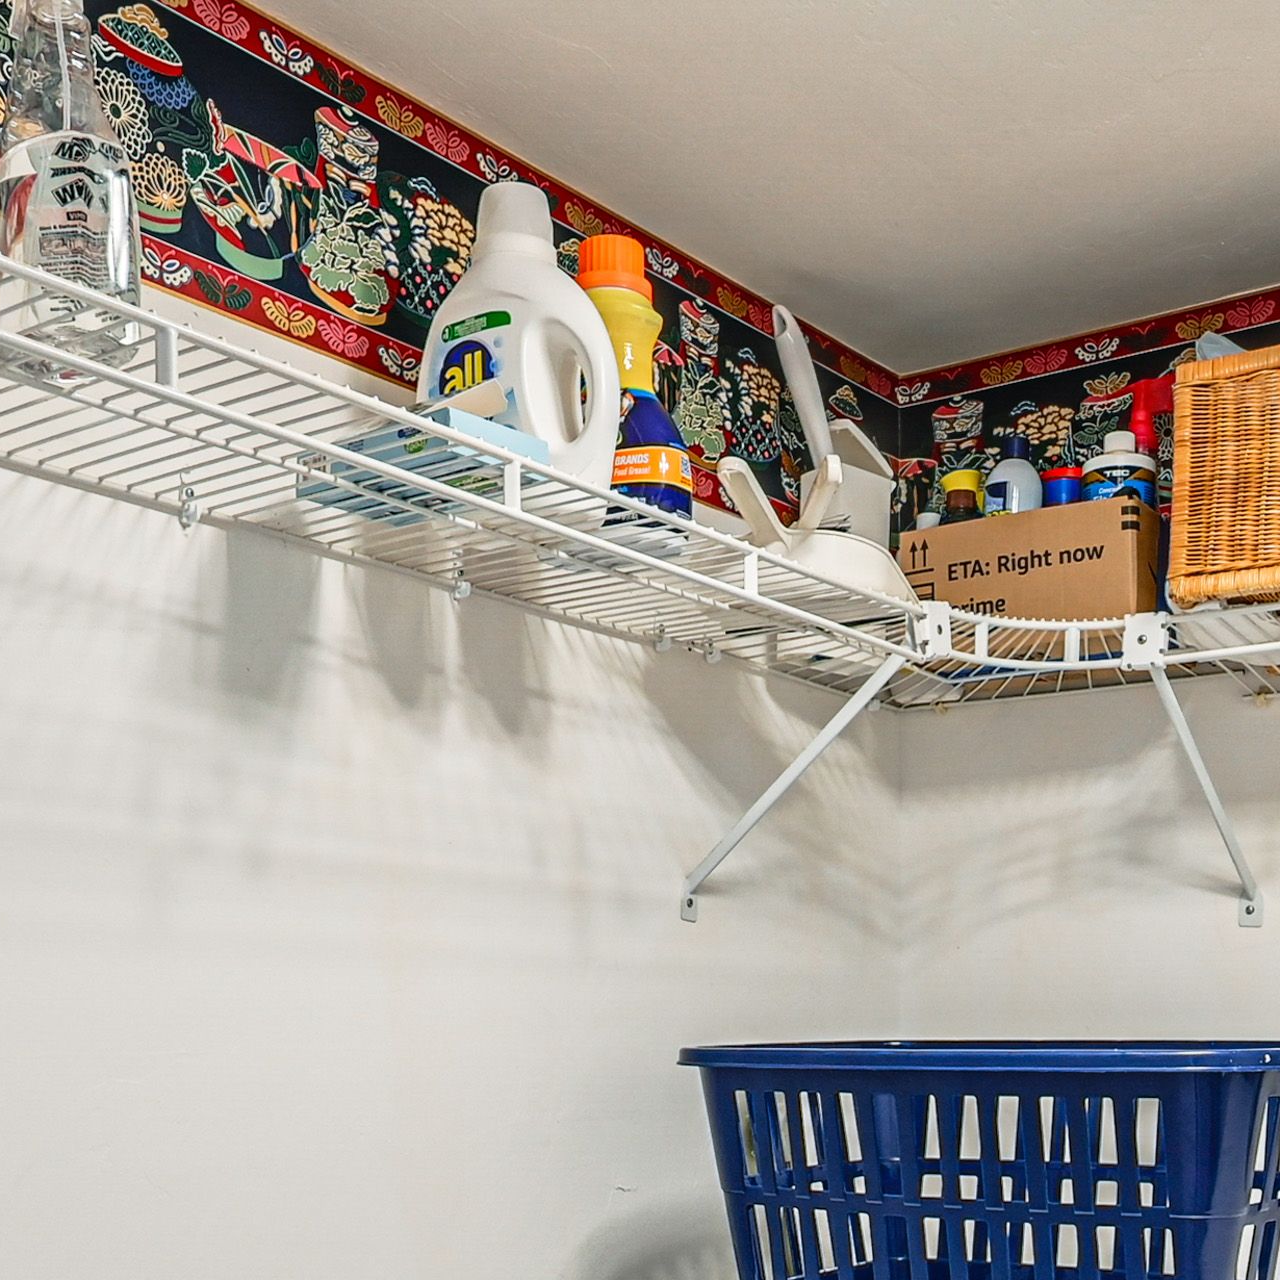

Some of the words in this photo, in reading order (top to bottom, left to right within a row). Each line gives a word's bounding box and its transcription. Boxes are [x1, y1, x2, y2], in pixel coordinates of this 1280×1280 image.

[444, 350, 483, 397] all
[1103, 469, 1130, 478] TEC
[947, 559, 990, 581] ETA:
[997, 549, 1052, 576] Right
[1059, 544, 1105, 565] now
